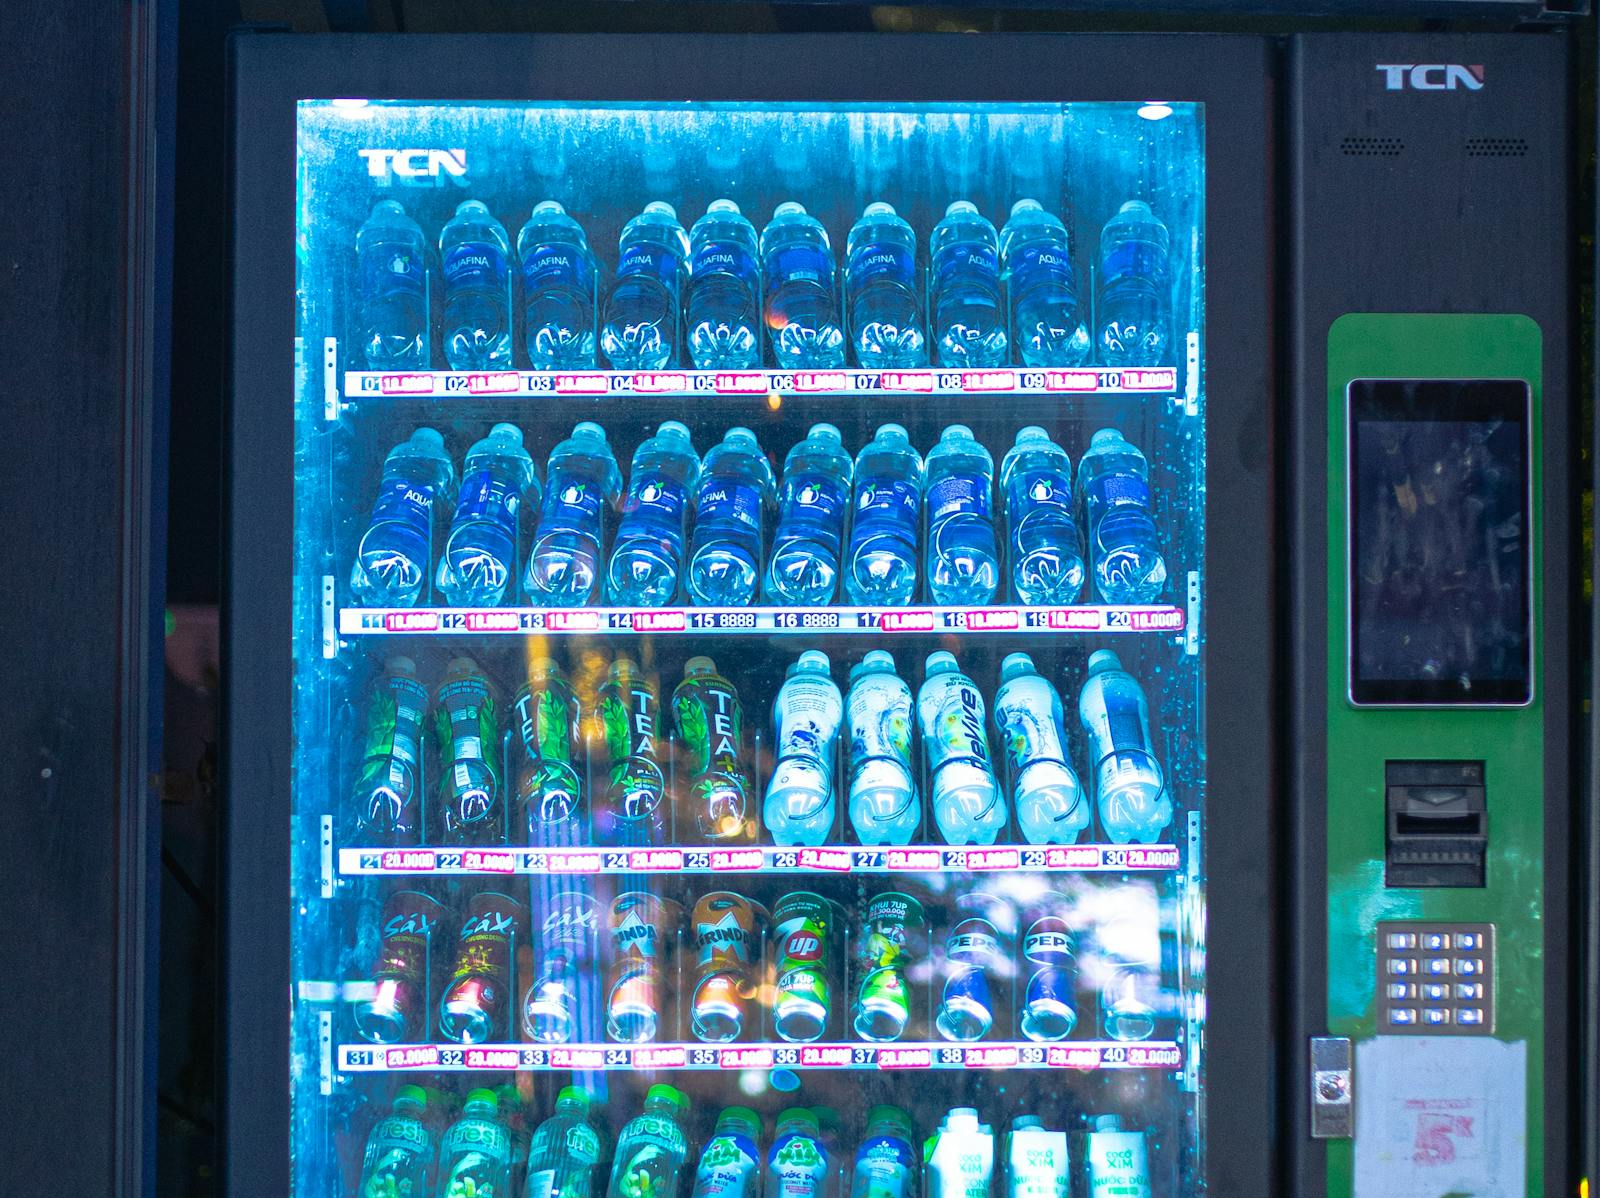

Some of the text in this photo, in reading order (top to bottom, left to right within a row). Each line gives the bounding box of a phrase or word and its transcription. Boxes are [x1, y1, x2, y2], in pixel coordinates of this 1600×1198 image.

[1375, 64, 1485, 90] TCN
[358, 148, 466, 177] TCN
[448, 378, 467, 390] 02
[531, 378, 551, 390] 03
[615, 377, 634, 390] 04
[696, 377, 715, 389] 05
[773, 377, 793, 389] 06
[858, 377, 878, 389] 07
[941, 375, 961, 388] 08
[1024, 375, 1045, 388] 09
[1100, 374, 1119, 387] 10
[366, 615, 386, 627] 11
[446, 615, 466, 628] 12
[524, 615, 544, 627] 13
[612, 614, 631, 627] 14
[695, 614, 714, 627] 15
[778, 614, 797, 627] 16
[862, 614, 880, 627] 17
[947, 614, 966, 626] 18
[1030, 614, 1048, 626] 19
[1111, 614, 1130, 626] 20
[631, 690, 657, 759] TEA
[708, 689, 737, 758] TEA
[364, 856, 381, 868] 21
[441, 855, 460, 867] 22
[527, 855, 547, 867] 23
[610, 854, 628, 867] 24
[689, 854, 708, 867] 25
[776, 854, 796, 866] 26
[858, 854, 876, 866] 27
[947, 854, 966, 866] 28
[1025, 854, 1046, 865] 29
[1106, 853, 1126, 865] 30
[1431, 936, 1440, 947] 2
[1463, 936, 1473, 946] 3
[1463, 961, 1473, 972] 6
[1398, 985, 1473, 997] 7 8 9
[351, 1052, 370, 1064] 31
[443, 1052, 462, 1064] 32
[524, 1052, 543, 1063] 33
[610, 1050, 627, 1063] 34
[694, 1050, 714, 1063] 35
[776, 1050, 797, 1062] 36
[855, 1050, 875, 1062] 37
[942, 1049, 962, 1062] 38
[1023, 1049, 1043, 1062] 39
[1104, 1049, 1124, 1061] 40
